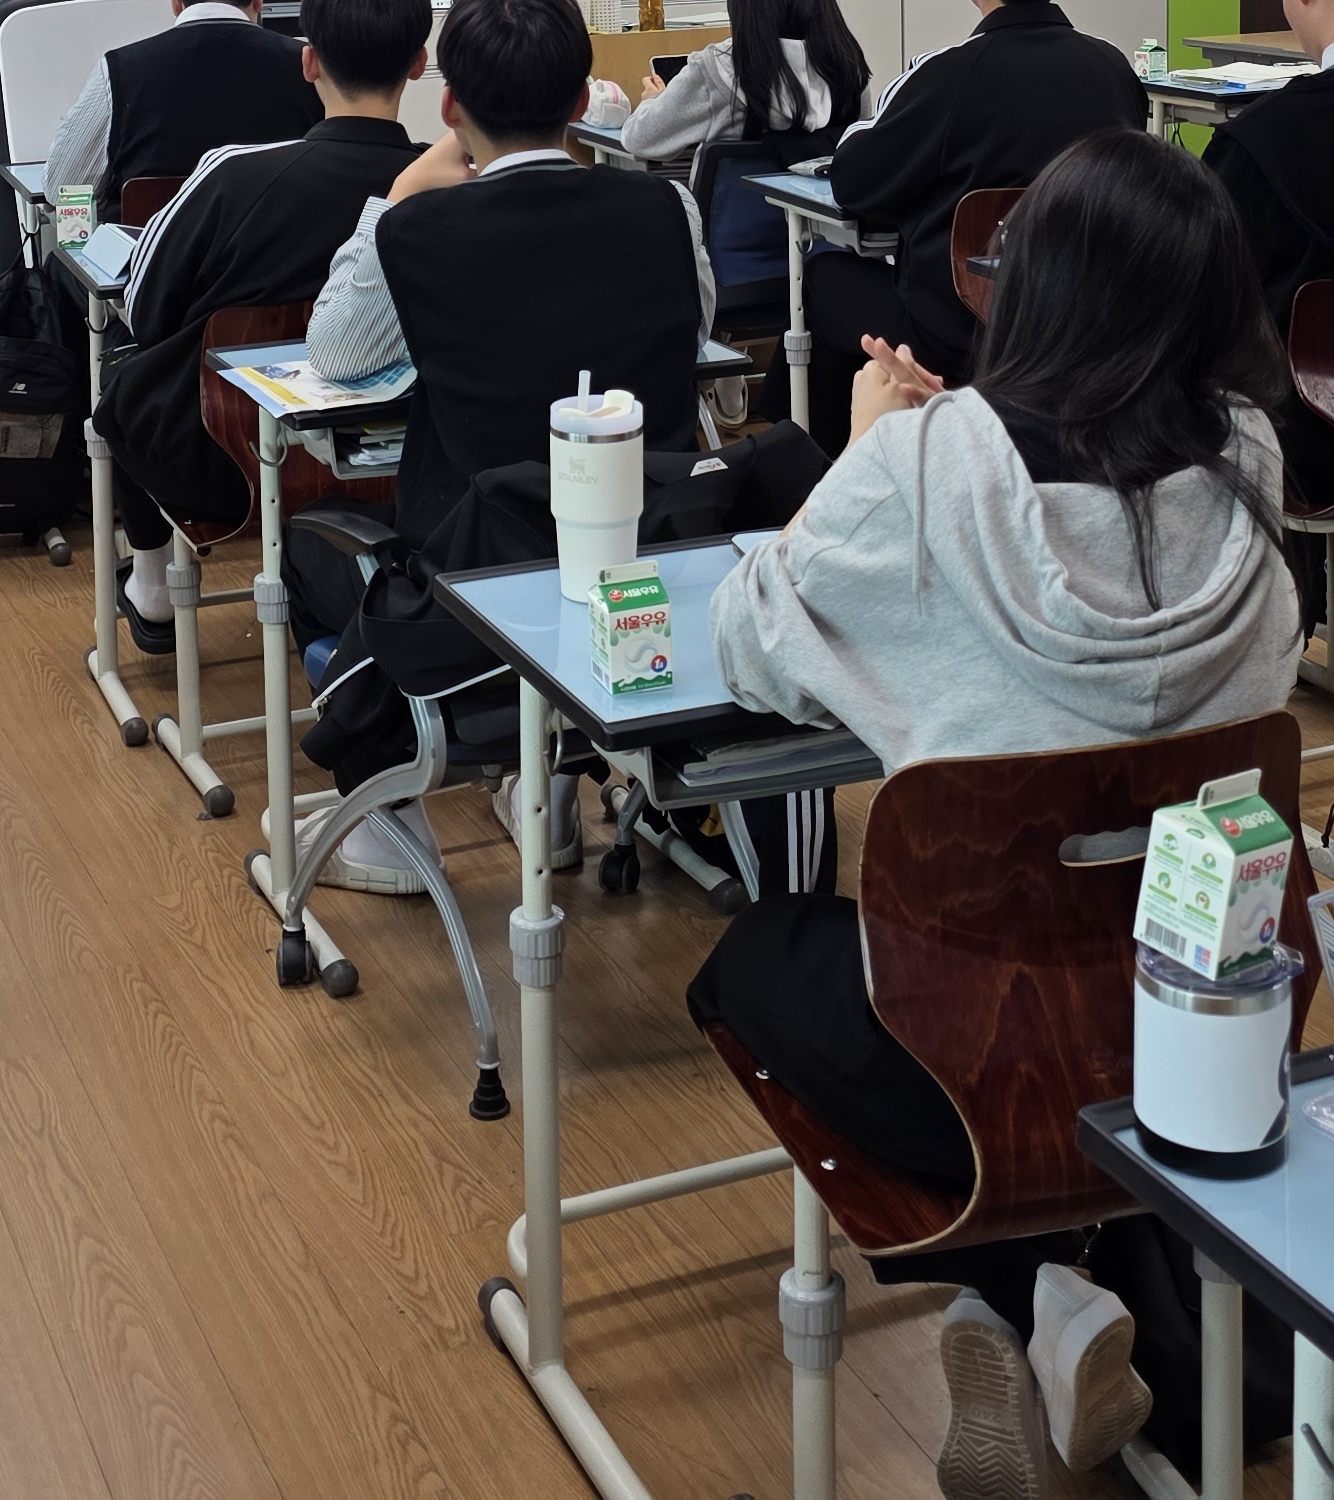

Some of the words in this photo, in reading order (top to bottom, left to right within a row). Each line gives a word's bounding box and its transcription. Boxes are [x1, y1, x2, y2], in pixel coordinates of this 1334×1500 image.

[60, 208, 88, 216] 서울우유
[557, 471, 599, 485] STANLEY
[623, 585, 659, 598] 서울우유
[614, 611, 666, 631] 서울우유
[1237, 809, 1275, 831] 서울우유
[1236, 852, 1287, 883] 서울우유
